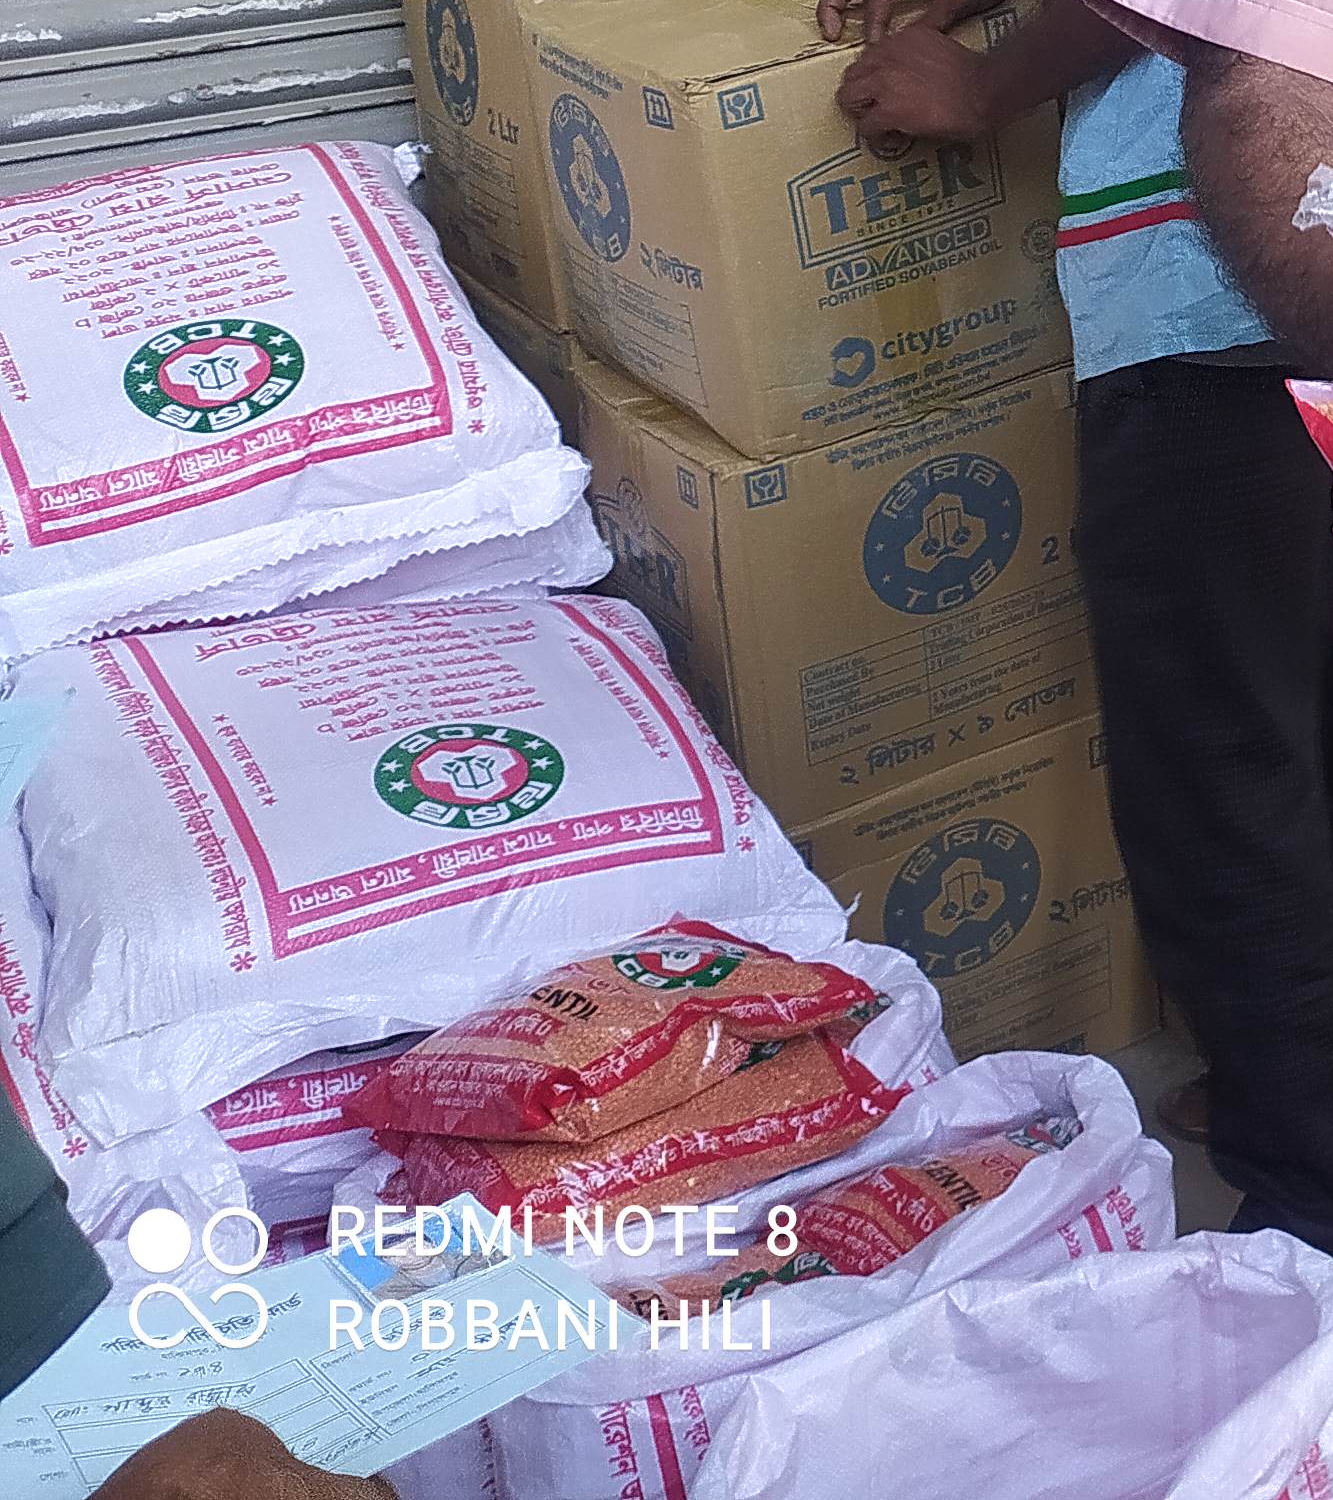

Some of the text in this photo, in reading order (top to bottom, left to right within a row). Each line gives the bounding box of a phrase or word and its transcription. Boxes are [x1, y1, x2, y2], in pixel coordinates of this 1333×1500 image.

[108, 173, 291, 218] মেসার্স রায়
[809, 143, 986, 235] TEER
[856, 213, 910, 238] SINCE
[830, 217, 989, 290] ADVANCED
[59, 268, 114, 285] ২০২২
[817, 241, 1003, 311] FORTIFIED SOYABEAN OIL
[89, 292, 136, 311] কেজি
[99, 306, 144, 323] কেজি
[102, 324, 139, 339] ডাল
[148, 322, 257, 354] TCB
[881, 299, 1017, 362] citygroup
[242, 427, 294, 456] দামে
[107, 468, 159, 496] মানে
[39, 485, 102, 512] অনন্য
[904, 561, 999, 611] TCB
[399, 724, 508, 755] TCB
[864, 732, 937, 776] লিটার
[1004, 677, 1077, 723] বোতল
[502, 828, 554, 856] দামে
[359, 864, 415, 891] মানে
[285, 882, 356, 915] অনন্য
[220, 901, 254, 949] অপরাধ
[925, 920, 1015, 973] TCB
[534, 983, 601, 1024] ENTIL
[225, 1087, 282, 1117] মানে
